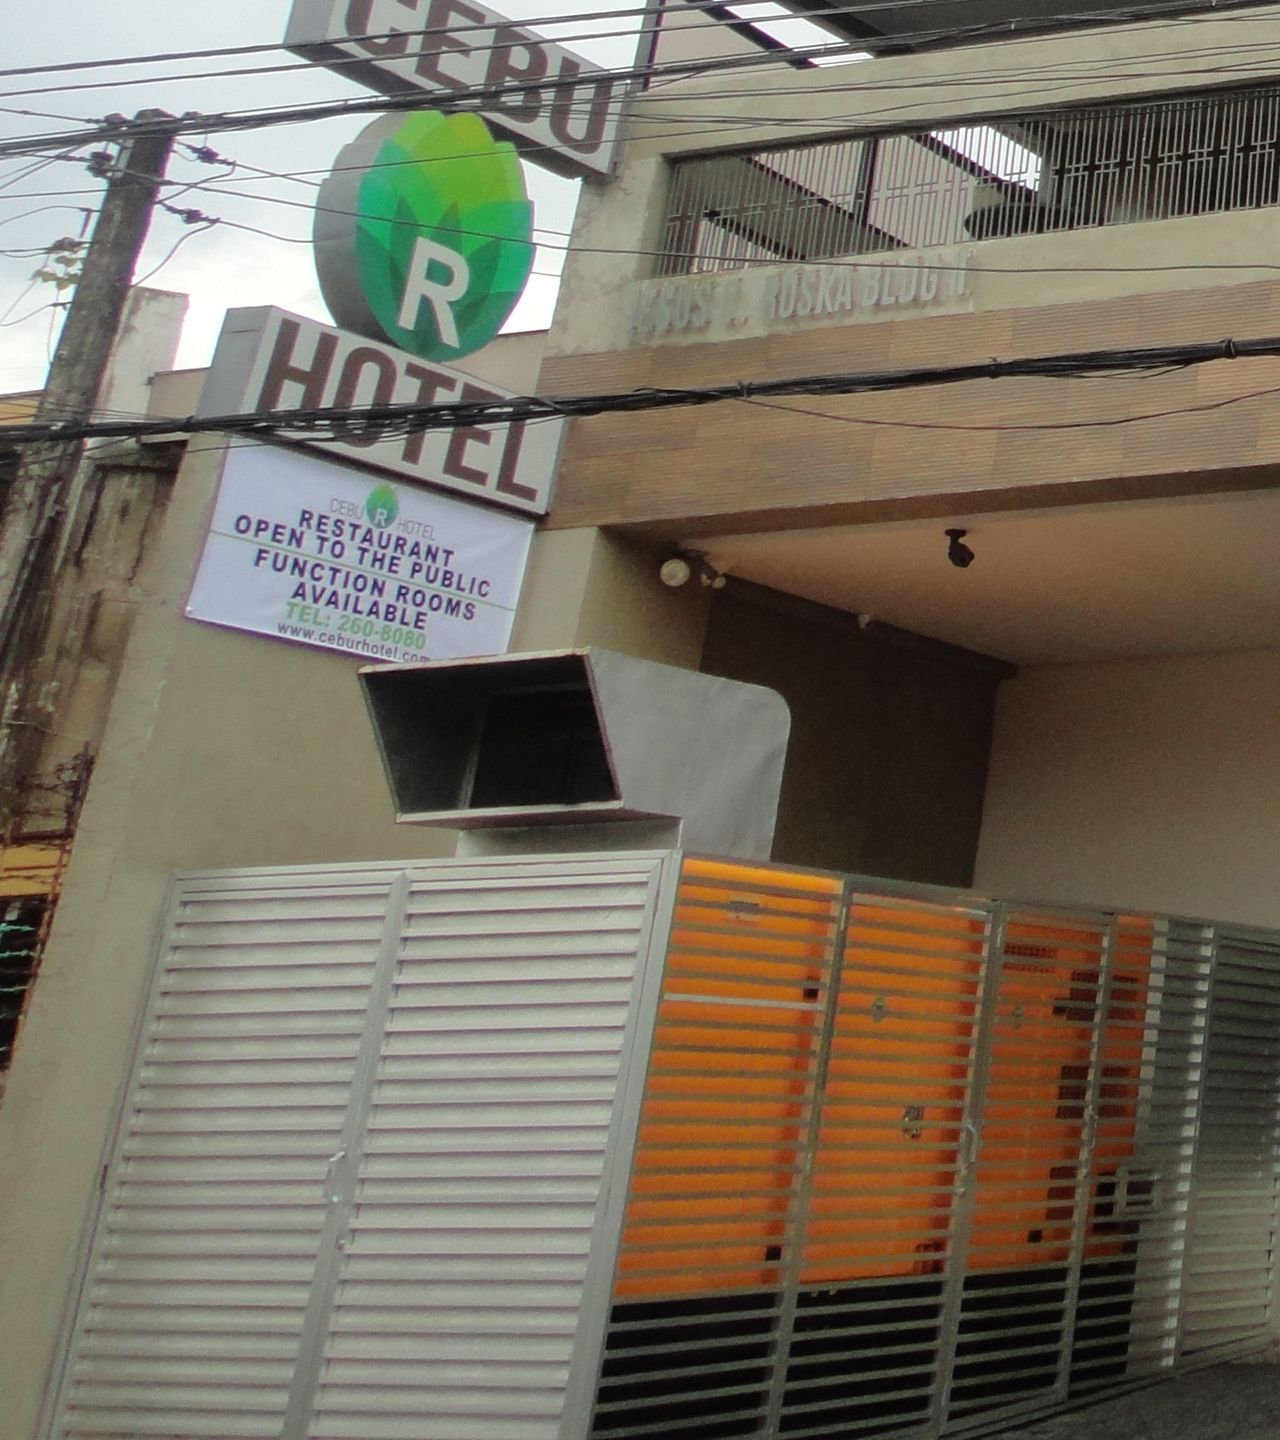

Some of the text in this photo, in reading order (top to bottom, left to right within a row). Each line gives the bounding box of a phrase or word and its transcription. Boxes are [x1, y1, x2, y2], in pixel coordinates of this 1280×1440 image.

[398, 237, 469, 348] R
[254, 318, 538, 502] HOTEL
[299, 509, 455, 567] RESTAURANT
[330, 498, 437, 541] CEBU R HOTEL
[234, 515, 491, 598] OPEN TO THE PUBLIC
[254, 548, 476, 621] FUNCTION ROOMS
[286, 602, 427, 650] TEL: 260-8080
[291, 581, 428, 630] AVAILABLE
